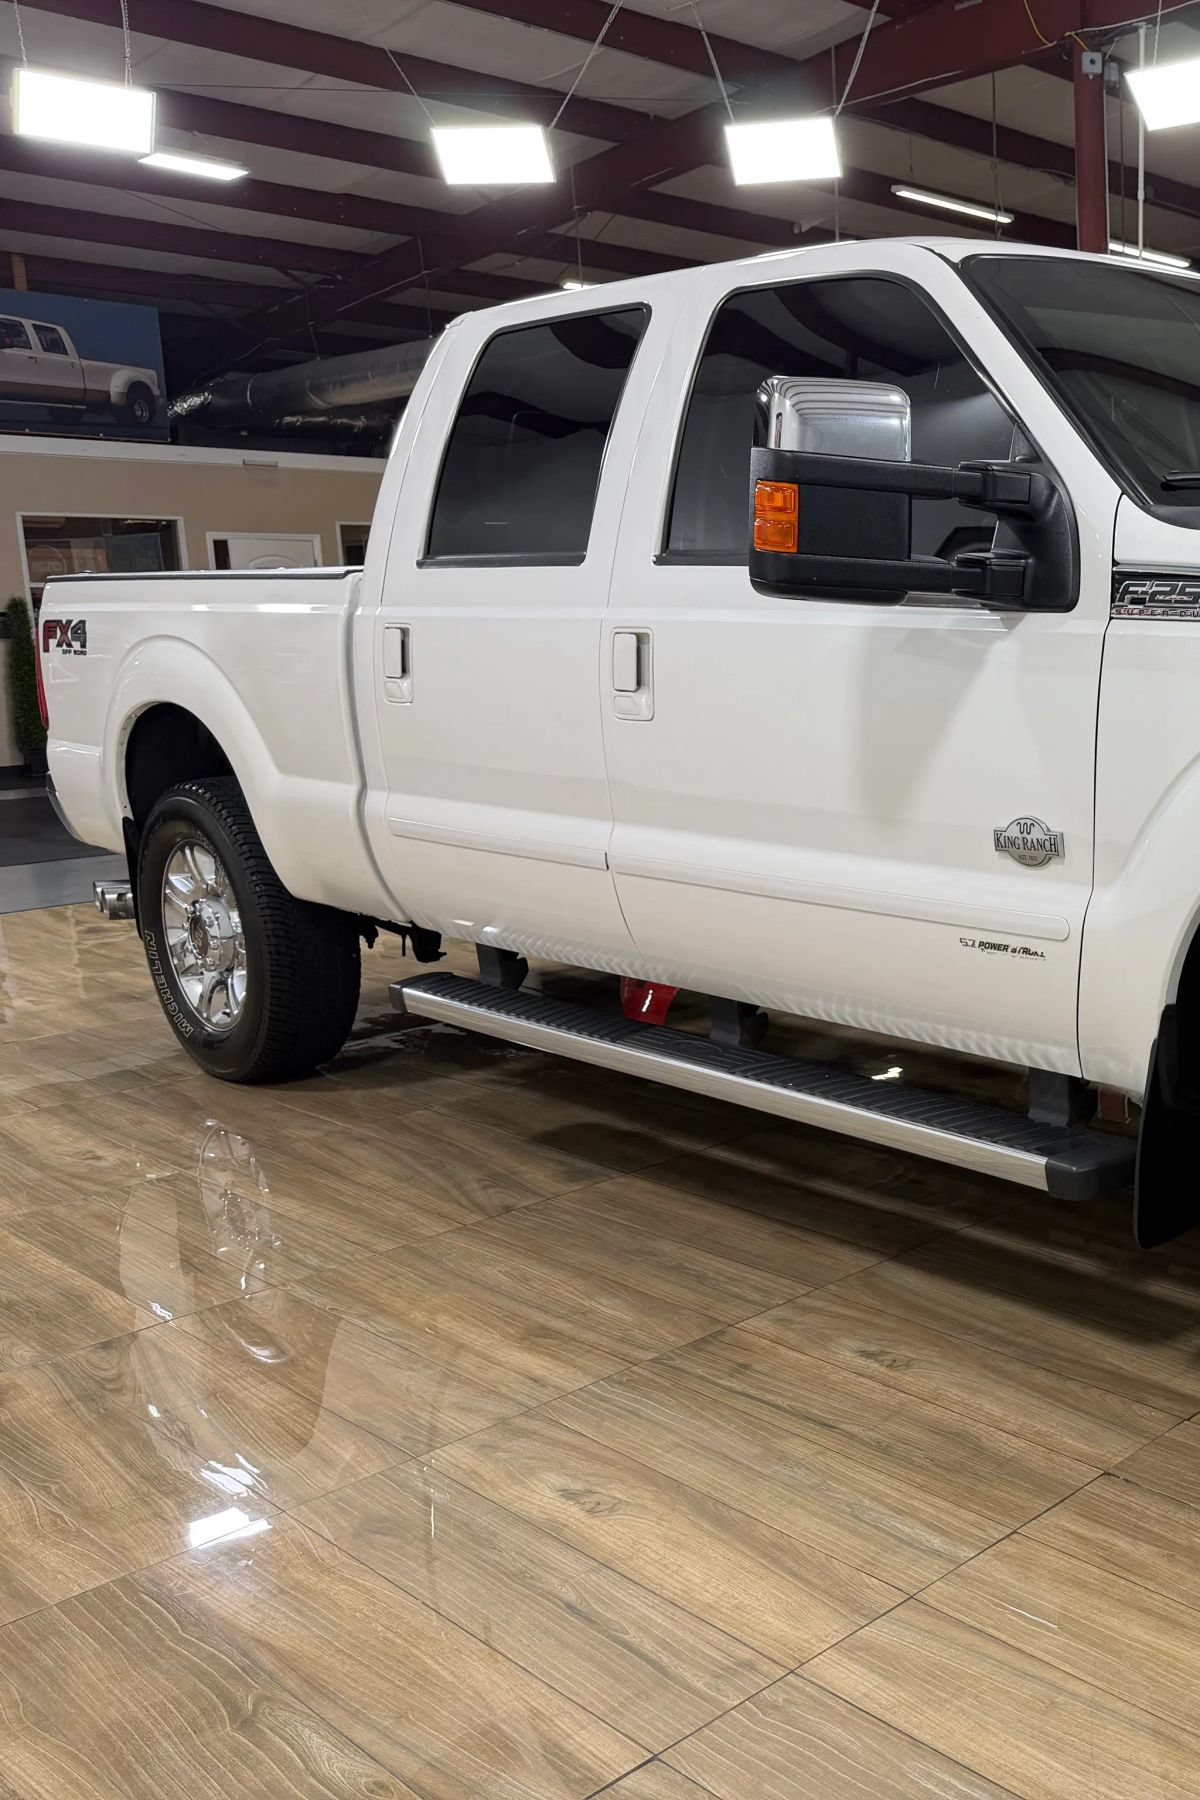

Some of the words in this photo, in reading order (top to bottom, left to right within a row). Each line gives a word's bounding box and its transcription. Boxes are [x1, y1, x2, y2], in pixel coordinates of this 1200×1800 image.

[1114, 608, 1170, 617] SUPER
[43, 619, 87, 653] FX4
[995, 832, 1020, 850] KING
[1023, 836, 1058, 853] RANCH
[978, 940, 1009, 953] POWER
[145, 930, 194, 1038] MICHELIN
